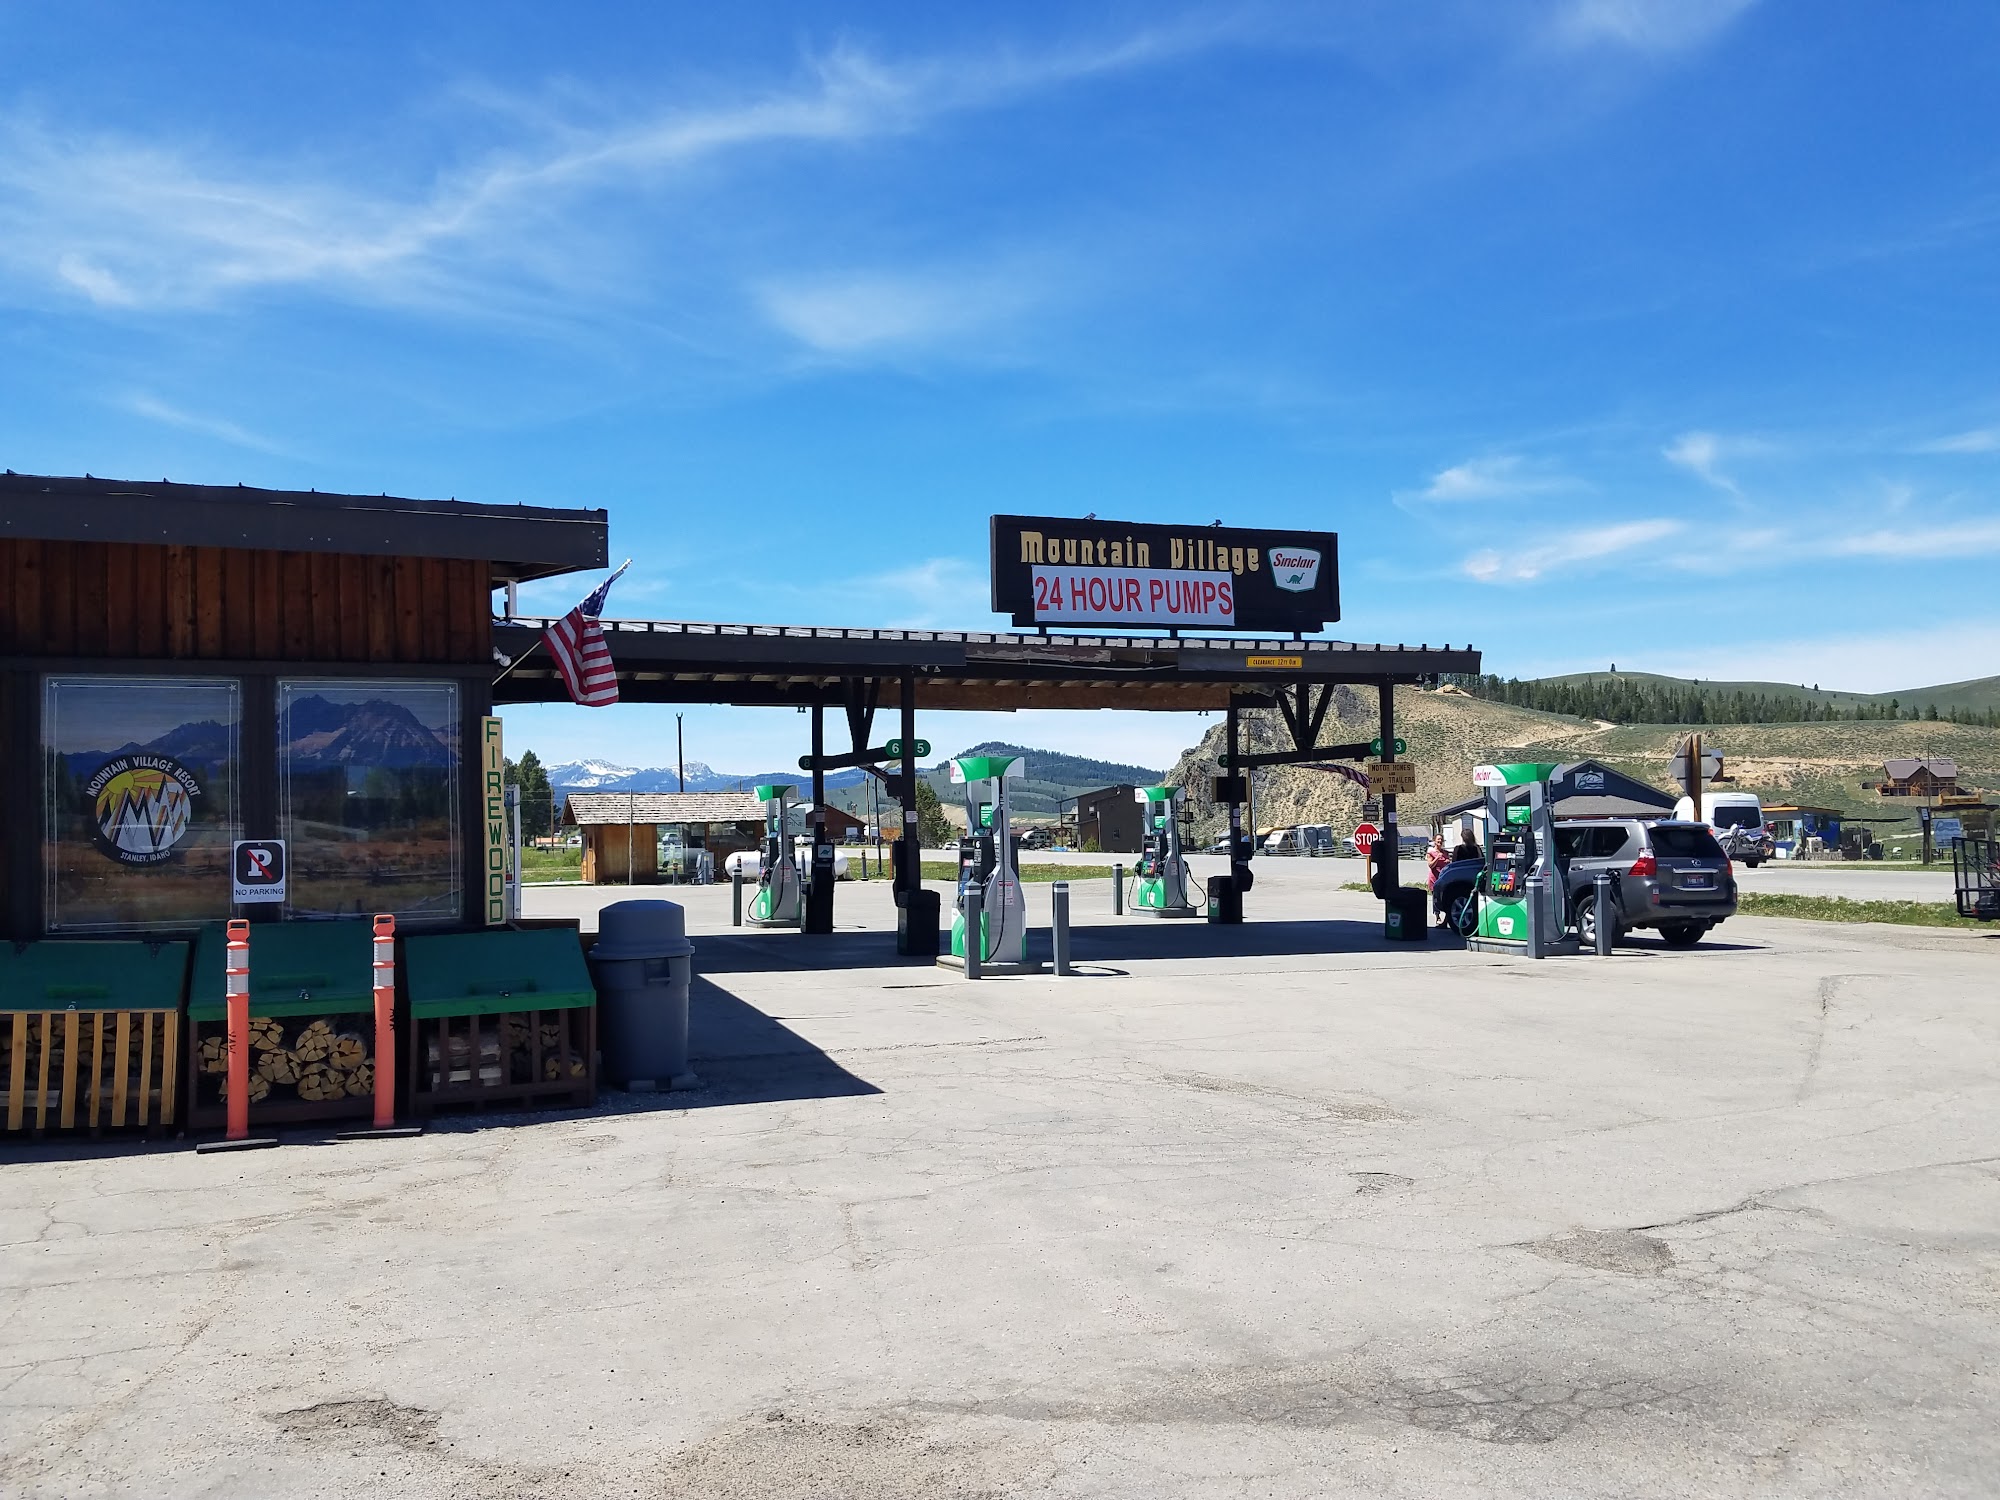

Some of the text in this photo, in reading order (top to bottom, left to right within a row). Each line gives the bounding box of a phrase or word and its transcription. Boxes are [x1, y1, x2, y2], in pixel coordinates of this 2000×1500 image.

[1020, 531, 1260, 575] Mountain Village
[1273, 553, 1317, 569] Sinclair
[1034, 576, 1233, 615] 24 HOUR PUMPS
[891, 742, 900, 754] 6
[916, 742, 925, 754] 5
[1375, 741, 1382, 752] 4
[1395, 741, 1402, 752] 3
[86, 756, 201, 797] MOUNTAIN VILLAGE RESORT
[1388, 776, 1416, 784] TRAILERS
[486, 720, 504, 923] FIREWOOD
[1355, 832, 1379, 846] STOP
[120, 849, 171, 863] STANLEY, IDAHO
[249, 887, 284, 896] PARKING
